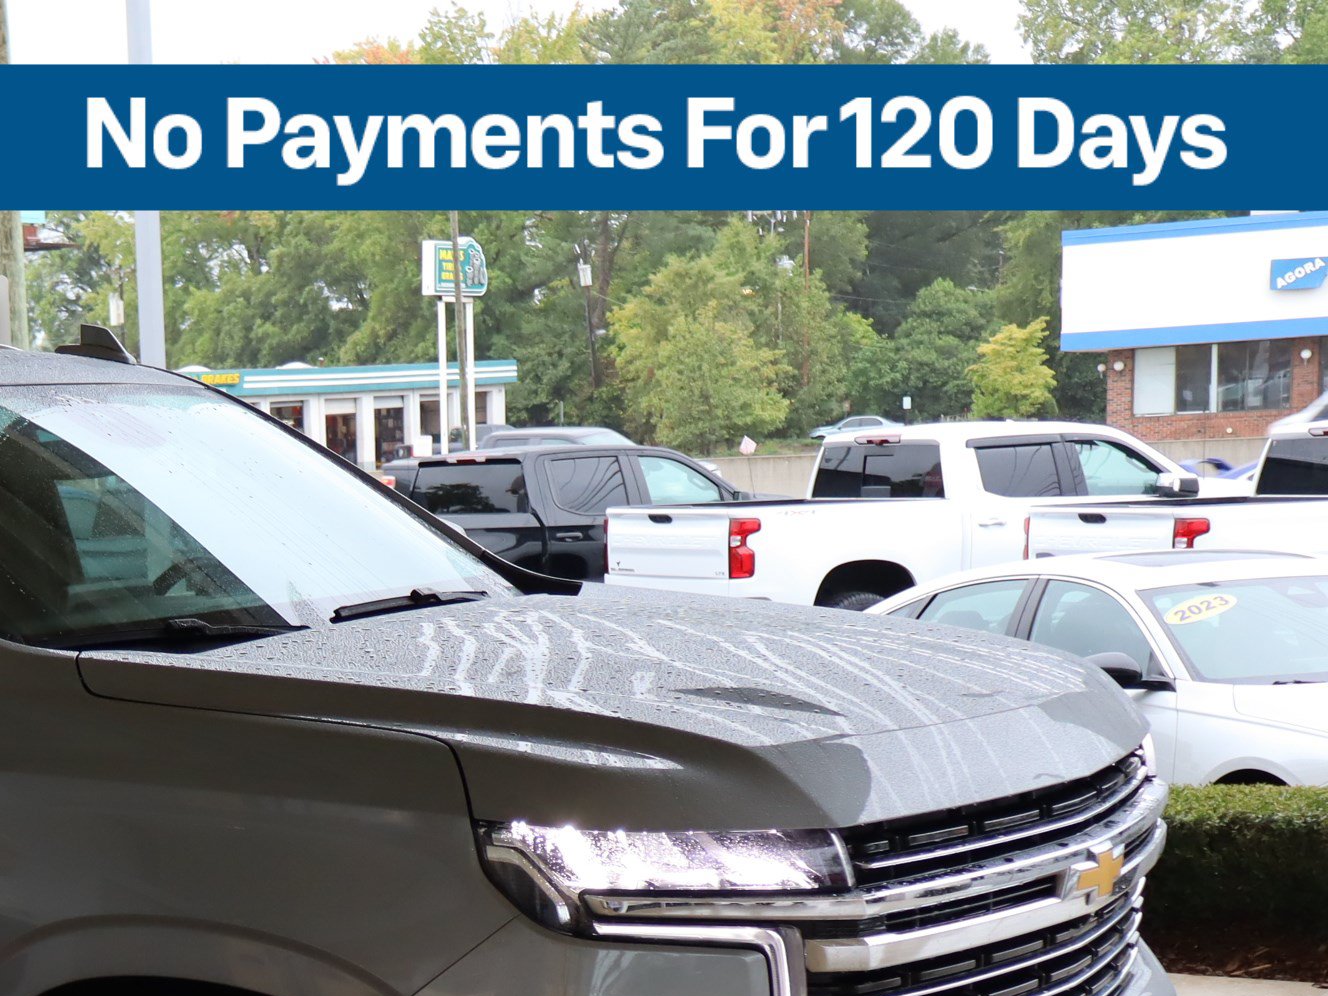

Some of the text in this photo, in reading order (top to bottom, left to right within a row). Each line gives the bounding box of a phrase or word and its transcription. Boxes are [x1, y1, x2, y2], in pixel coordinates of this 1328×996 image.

[1276, 257, 1326, 289] AGORA
[202, 373, 240, 385] BRAKES
[1173, 595, 1230, 622] 2023
